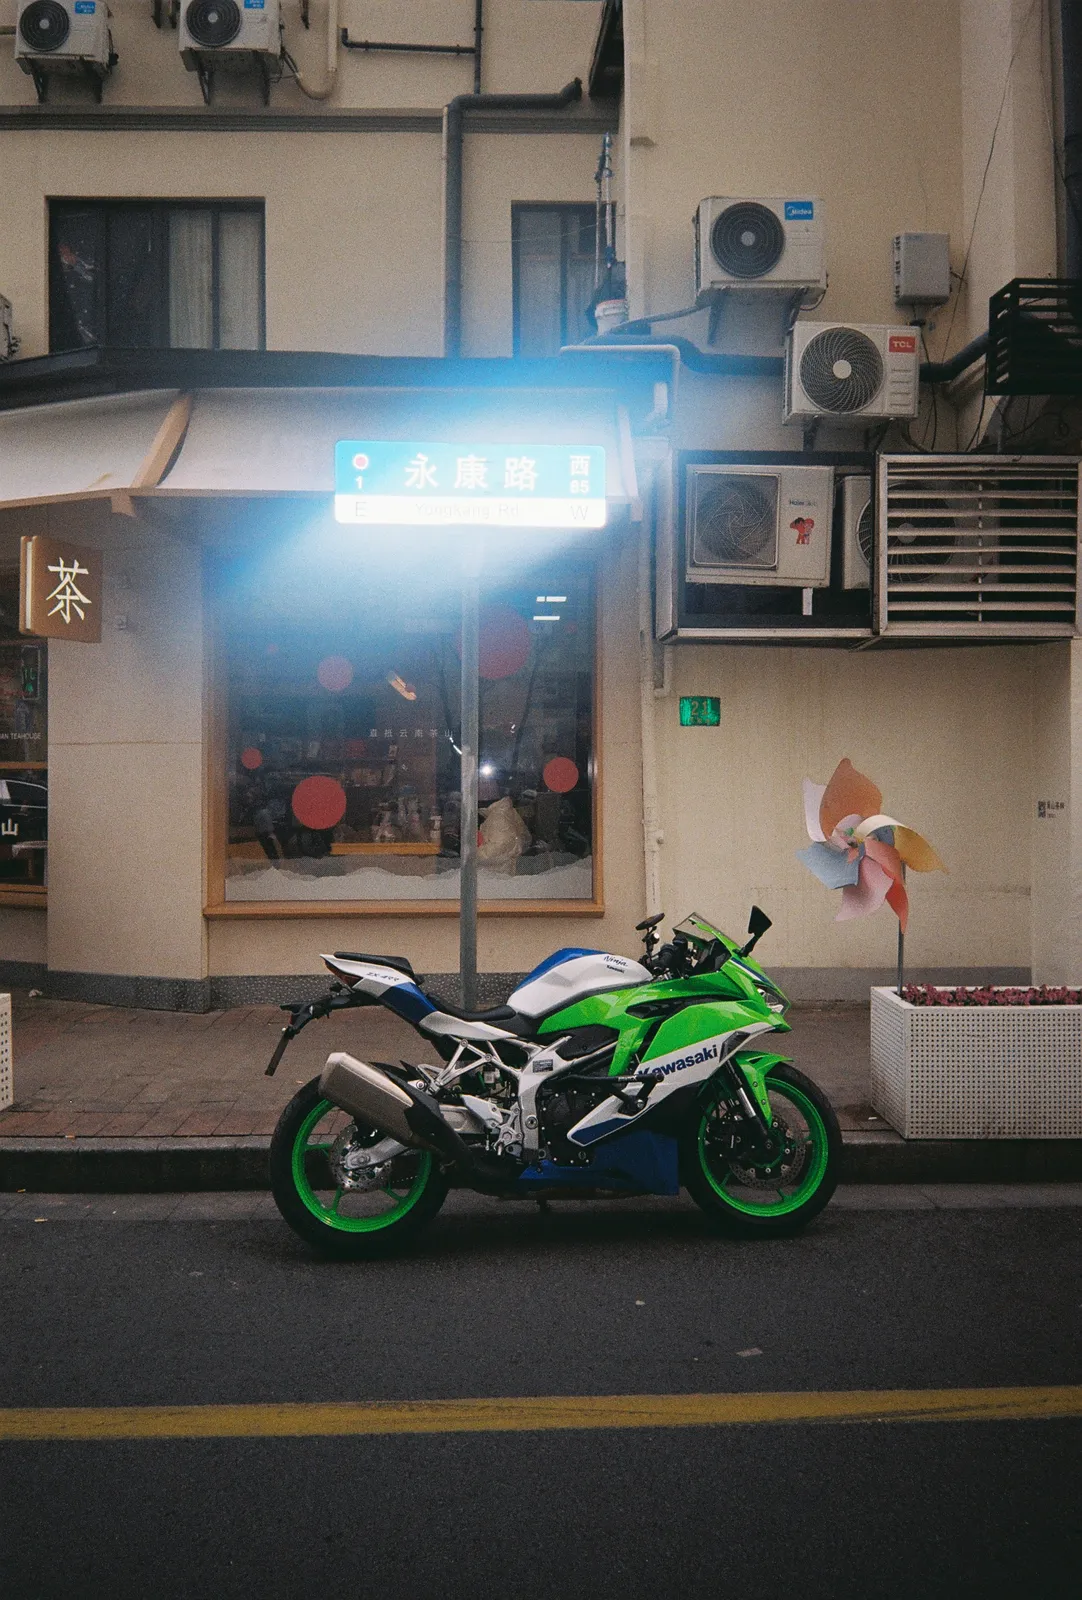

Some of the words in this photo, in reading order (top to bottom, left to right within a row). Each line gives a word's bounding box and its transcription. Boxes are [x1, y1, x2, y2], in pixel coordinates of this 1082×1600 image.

[404, 452, 539, 491] 永康路
[569, 455, 591, 476] 西
[355, 475, 363, 489] 1
[355, 501, 367, 517] E
[499, 503, 519, 518] Rd
[570, 505, 589, 520] W
[45, 556, 92, 624] 茶
[691, 700, 709, 716] 21
[1, 818, 19, 836] 山
[603, 955, 628, 967] Ninja
